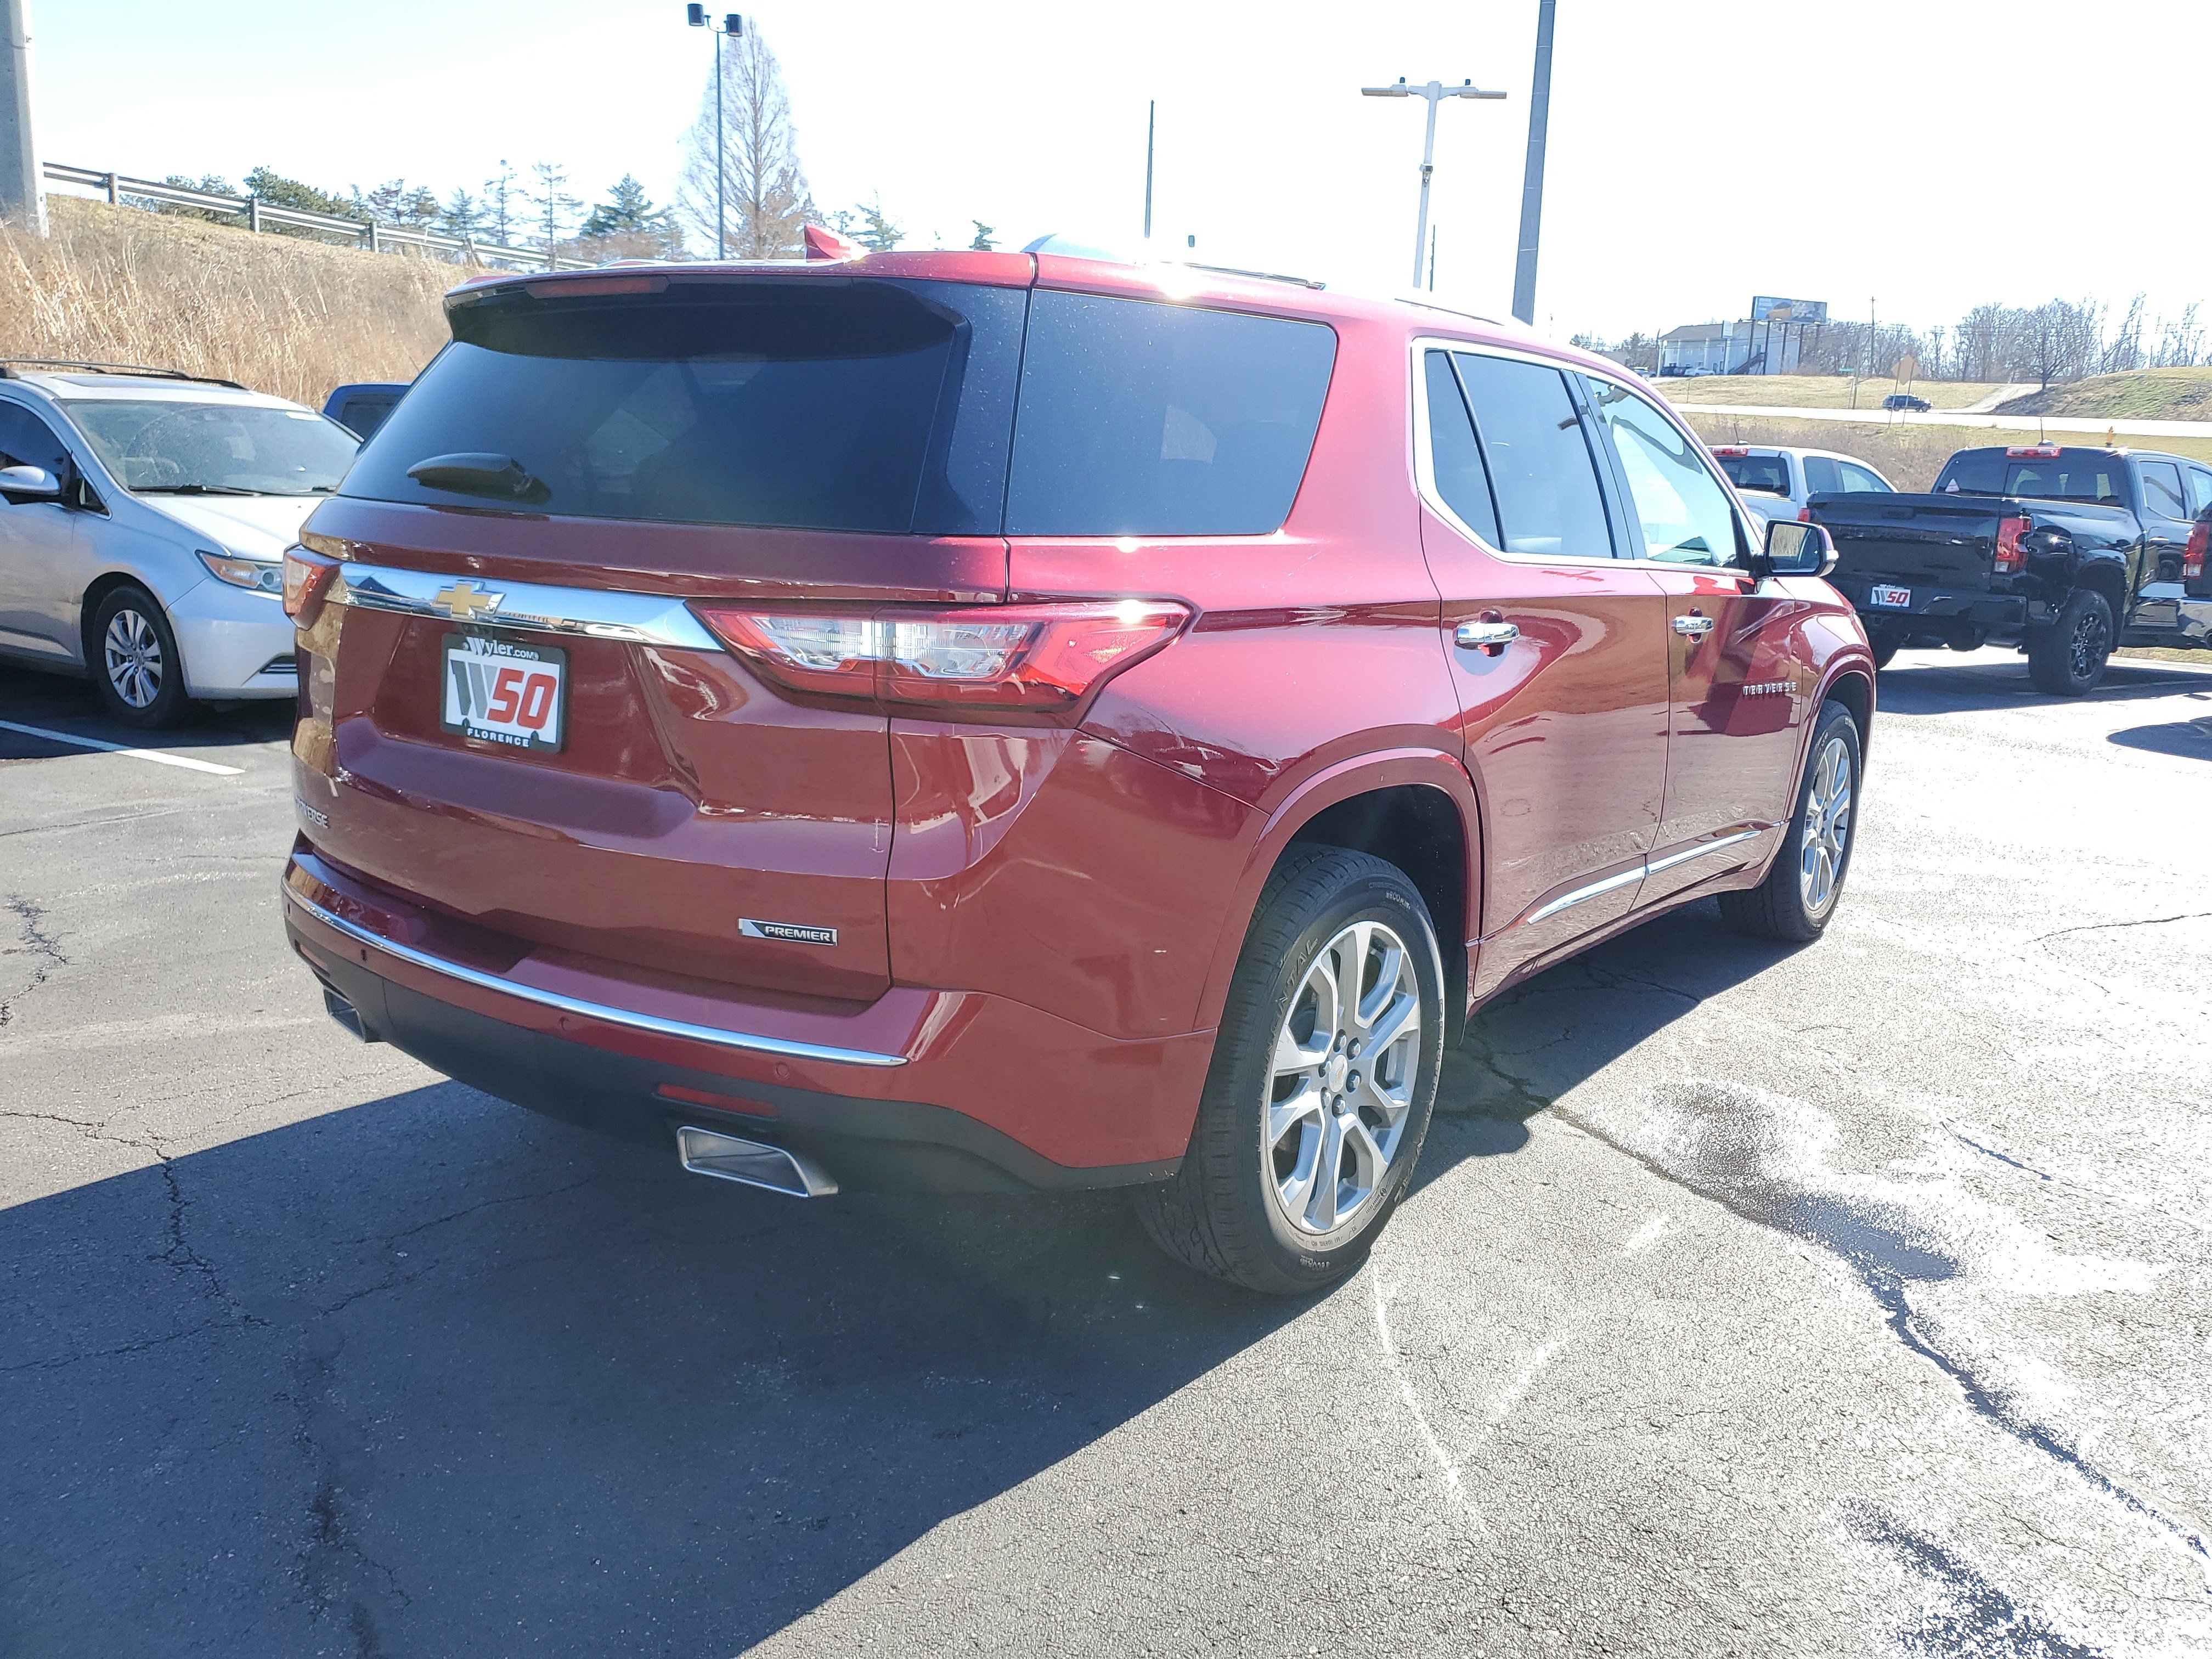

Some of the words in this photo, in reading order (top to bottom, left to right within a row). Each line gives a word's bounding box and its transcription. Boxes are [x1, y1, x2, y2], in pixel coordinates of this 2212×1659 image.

[1743, 682, 1797, 696] TRAVERSE
[467, 727, 530, 748] FLORENCE
[765, 926, 831, 942] PREMIER
